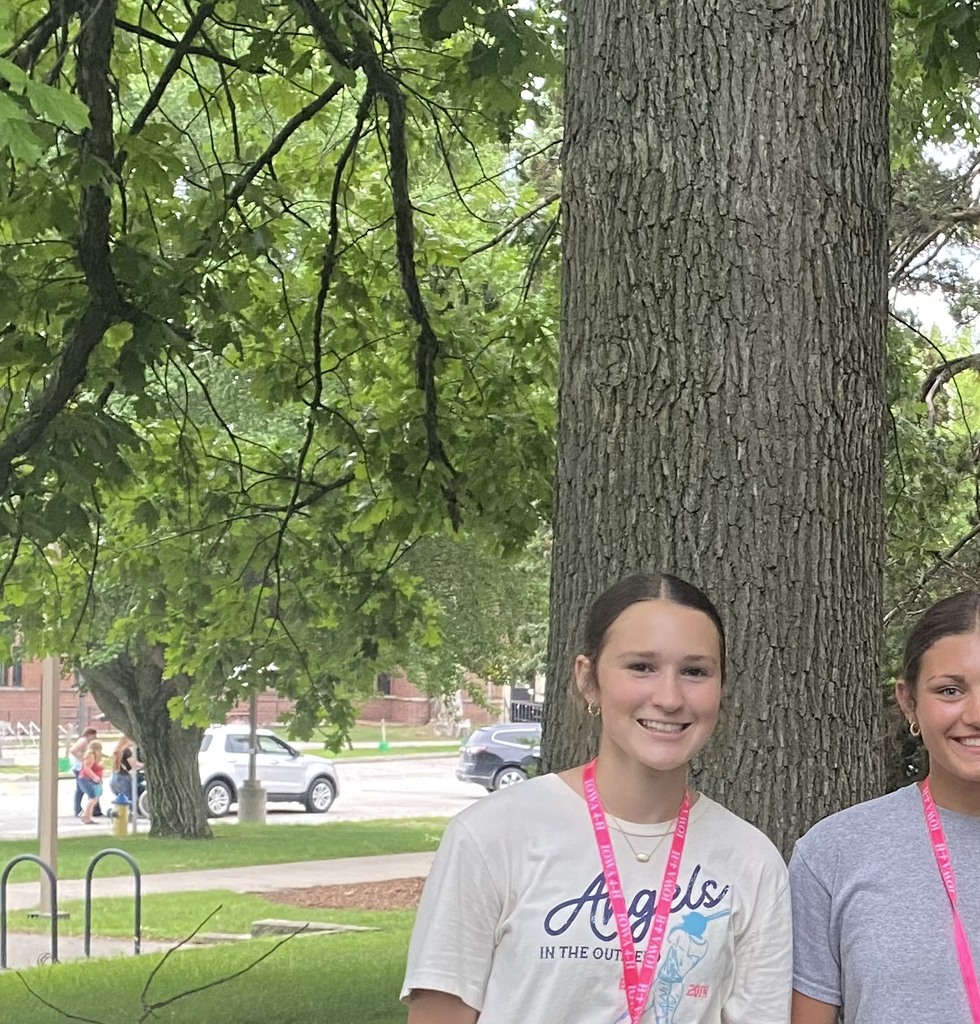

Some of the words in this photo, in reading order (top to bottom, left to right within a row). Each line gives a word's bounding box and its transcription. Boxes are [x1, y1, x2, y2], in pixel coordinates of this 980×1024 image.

[584, 780, 601, 811] IOWA
[600, 844, 617, 879] IOWA
[608, 880, 623, 899] 4-H
[661, 872, 676, 902] IOWA
[941, 862, 955, 893] IOWA
[544, 864, 729, 943] Angels
[617, 913, 632, 947] IOWA
[644, 935, 662, 969] IOWA
[654, 914, 667, 935] 4-H
[540, 947, 556, 960] IN
[559, 946, 589, 959] THE
[593, 946, 662, 963] OUTE
[624, 949, 636, 969] 4-H
